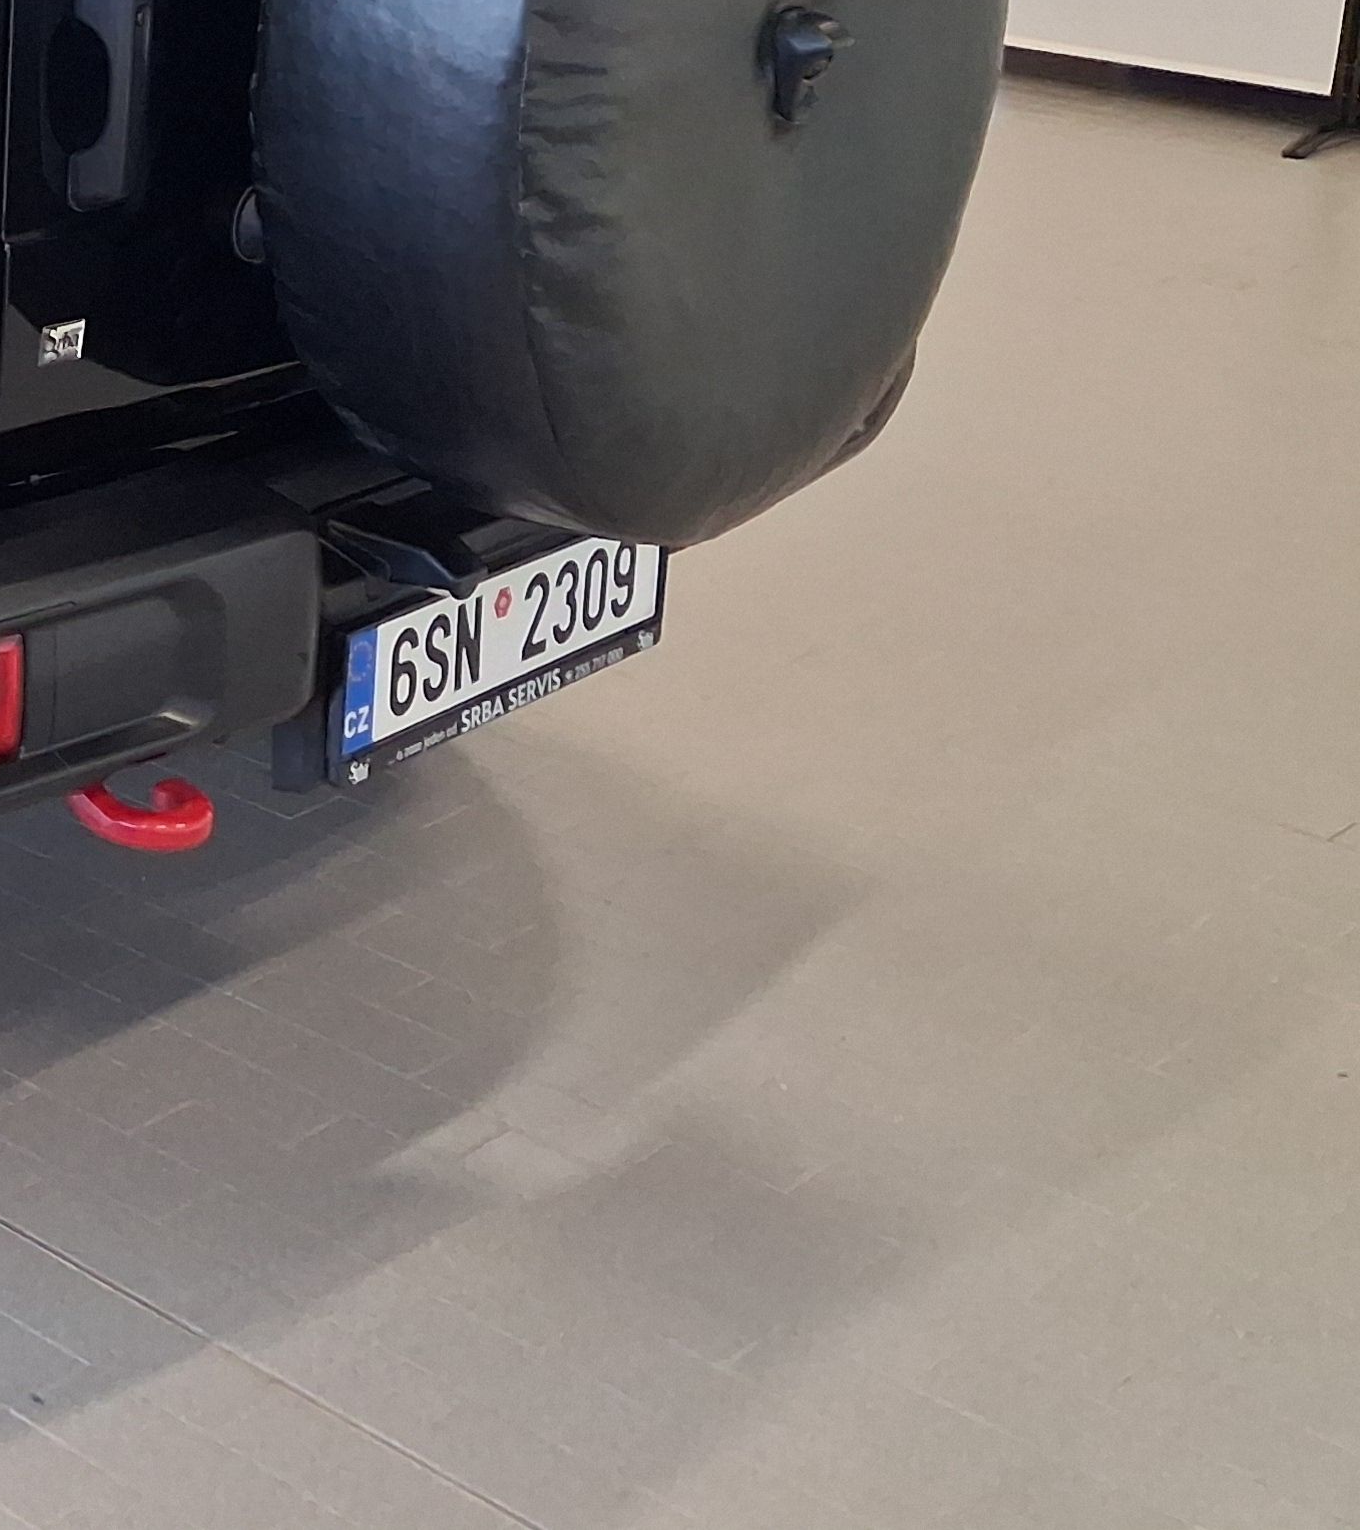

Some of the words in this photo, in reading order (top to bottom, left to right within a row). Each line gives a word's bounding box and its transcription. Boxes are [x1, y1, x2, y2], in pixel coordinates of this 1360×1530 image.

[389, 596, 484, 717] 6SN
[520, 542, 637, 662] 2309
[343, 704, 370, 739] CZ
[460, 694, 506, 734] SRBA
[507, 667, 562, 711] SERVIS
